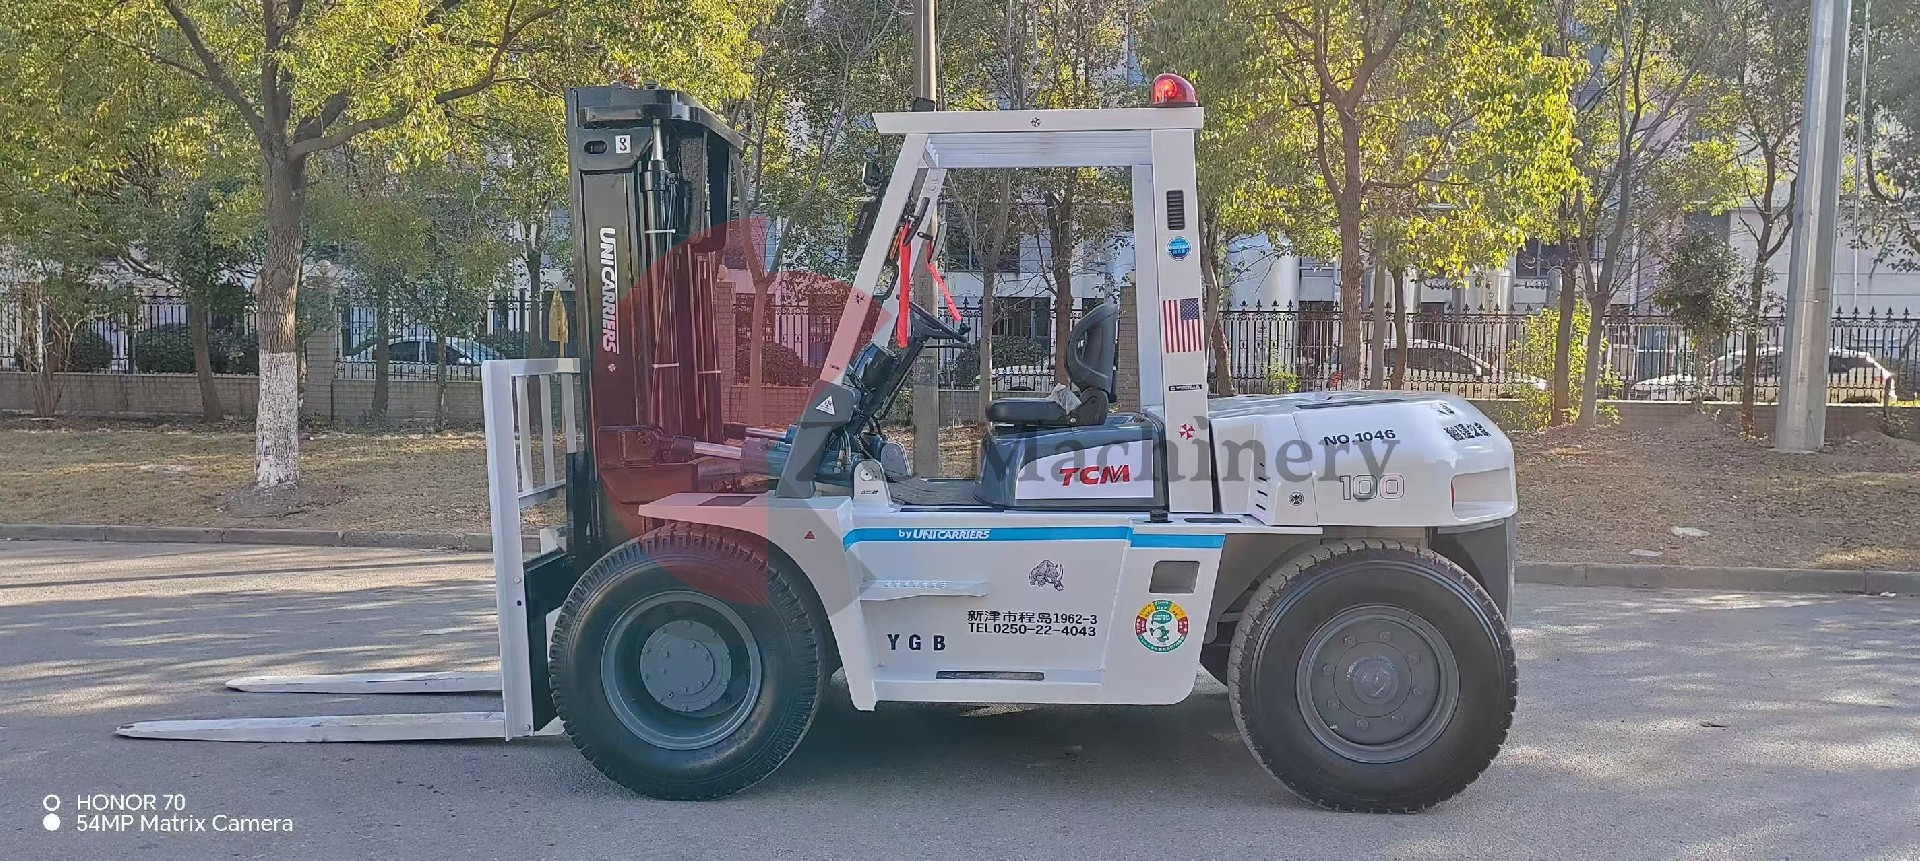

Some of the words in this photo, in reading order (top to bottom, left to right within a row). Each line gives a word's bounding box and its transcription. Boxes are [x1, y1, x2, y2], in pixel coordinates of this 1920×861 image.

[600, 226, 619, 354] UNICARRIERS
[1323, 429, 1396, 446] NO.1046
[1059, 464, 1131, 487] TCM
[1339, 474, 1405, 501] 100
[898, 529, 912, 539] by
[912, 528, 991, 540] UNICARRIERS
